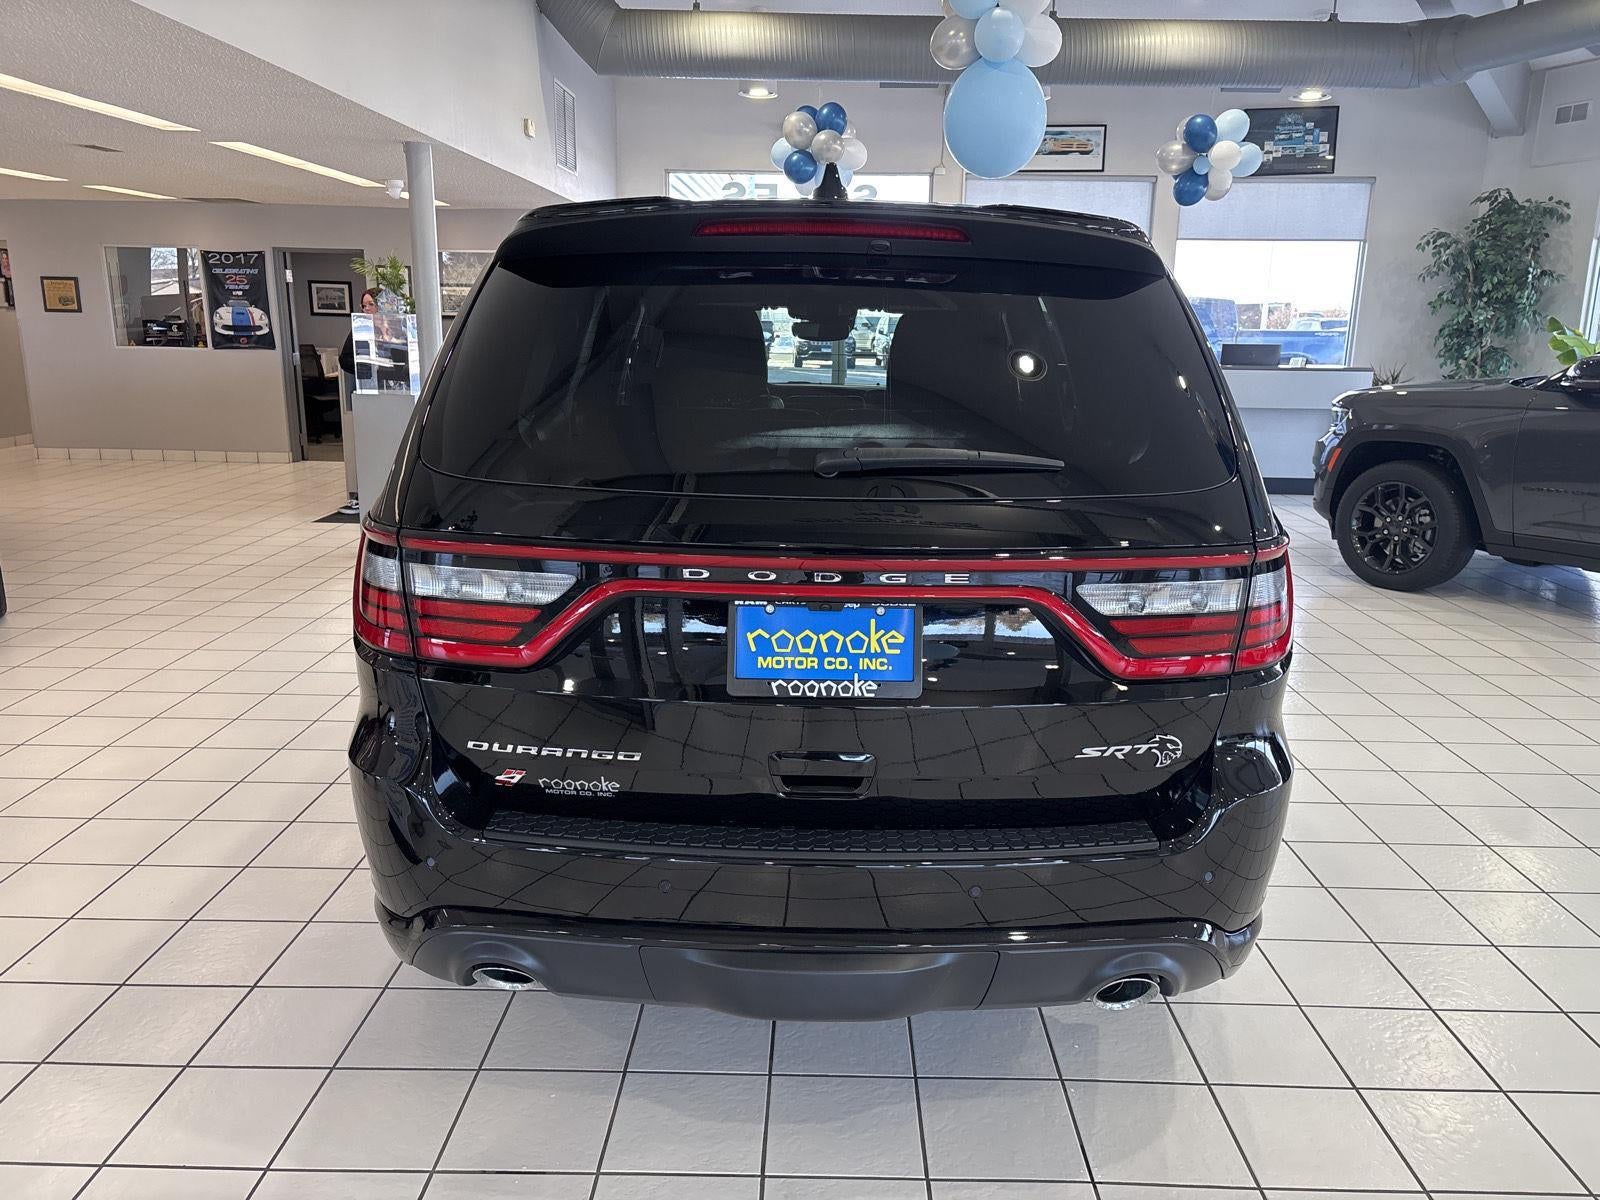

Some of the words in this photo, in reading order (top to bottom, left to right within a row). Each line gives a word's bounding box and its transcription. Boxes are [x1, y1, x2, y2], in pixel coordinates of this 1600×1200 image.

[208, 253, 258, 264] 2017
[226, 274, 247, 284] 25
[682, 568, 970, 584] DODGE
[746, 618, 906, 655] roanoke
[757, 656, 818, 669] MOTOR
[824, 657, 852, 670] CO.
[859, 658, 893, 671] INC.
[770, 672, 878, 697] roanoke
[466, 740, 642, 761] DURANGO
[1074, 743, 1159, 760] SRT
[538, 776, 621, 793] roanoke
[545, 788, 577, 796] MOTOR
